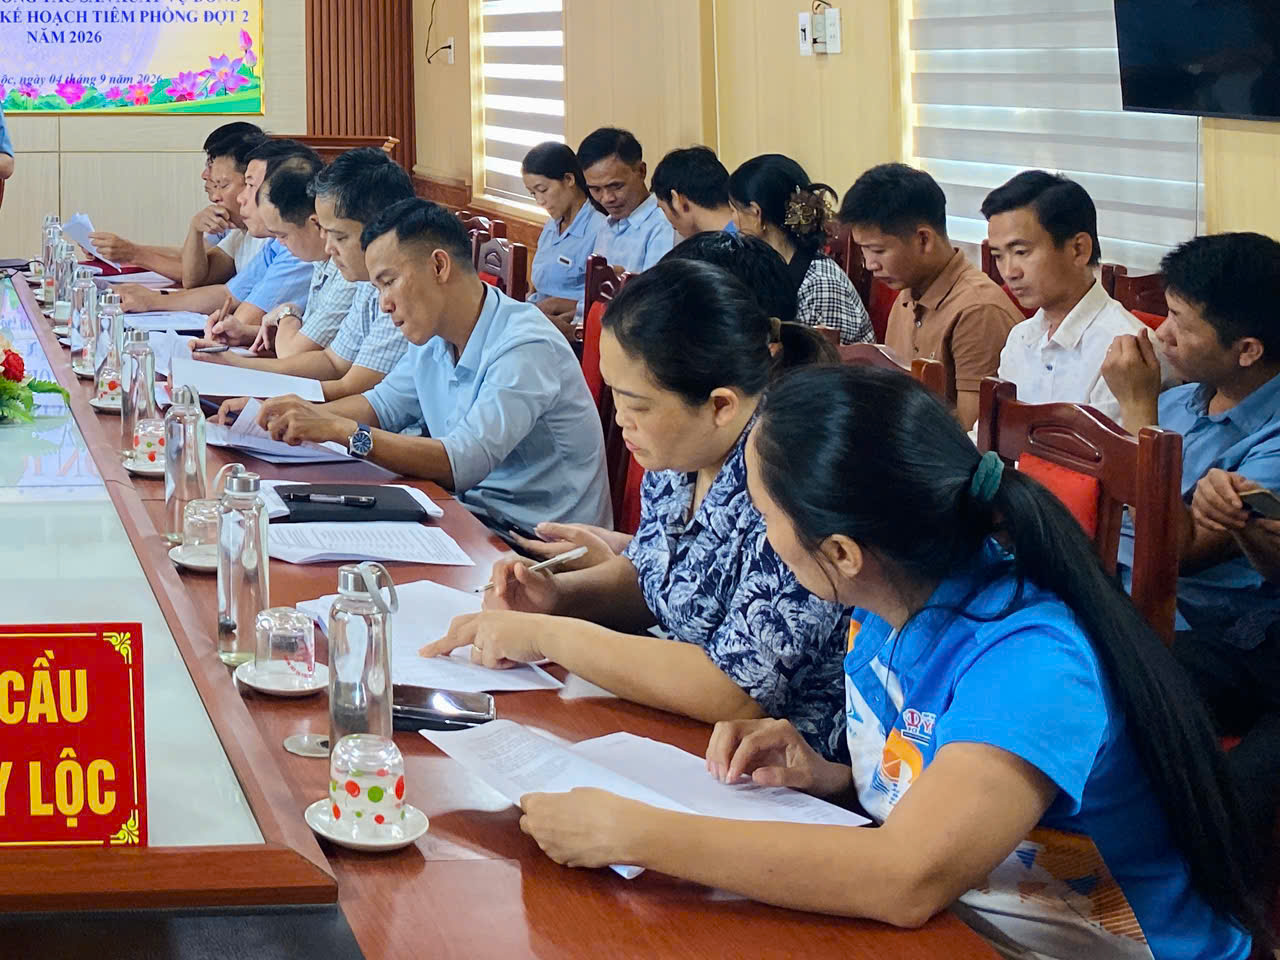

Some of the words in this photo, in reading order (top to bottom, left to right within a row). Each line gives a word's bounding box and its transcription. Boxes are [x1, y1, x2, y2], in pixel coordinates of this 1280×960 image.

[27, 10, 88, 26] HOẠCH
[92, 6, 135, 23] TIÊM
[140, 7, 198, 23] PHÒNG
[203, 10, 237, 26] ĐỢT
[241, 10, 249, 23] 2
[26, 28, 65, 43] NĂM
[69, 30, 103, 43] 2026
[48, 74, 63, 85] 04
[65, 73, 97, 87] tháng
[100, 74, 107, 85] 9
[109, 74, 134, 85] năm
[29, 746, 117, 828] LỘC
